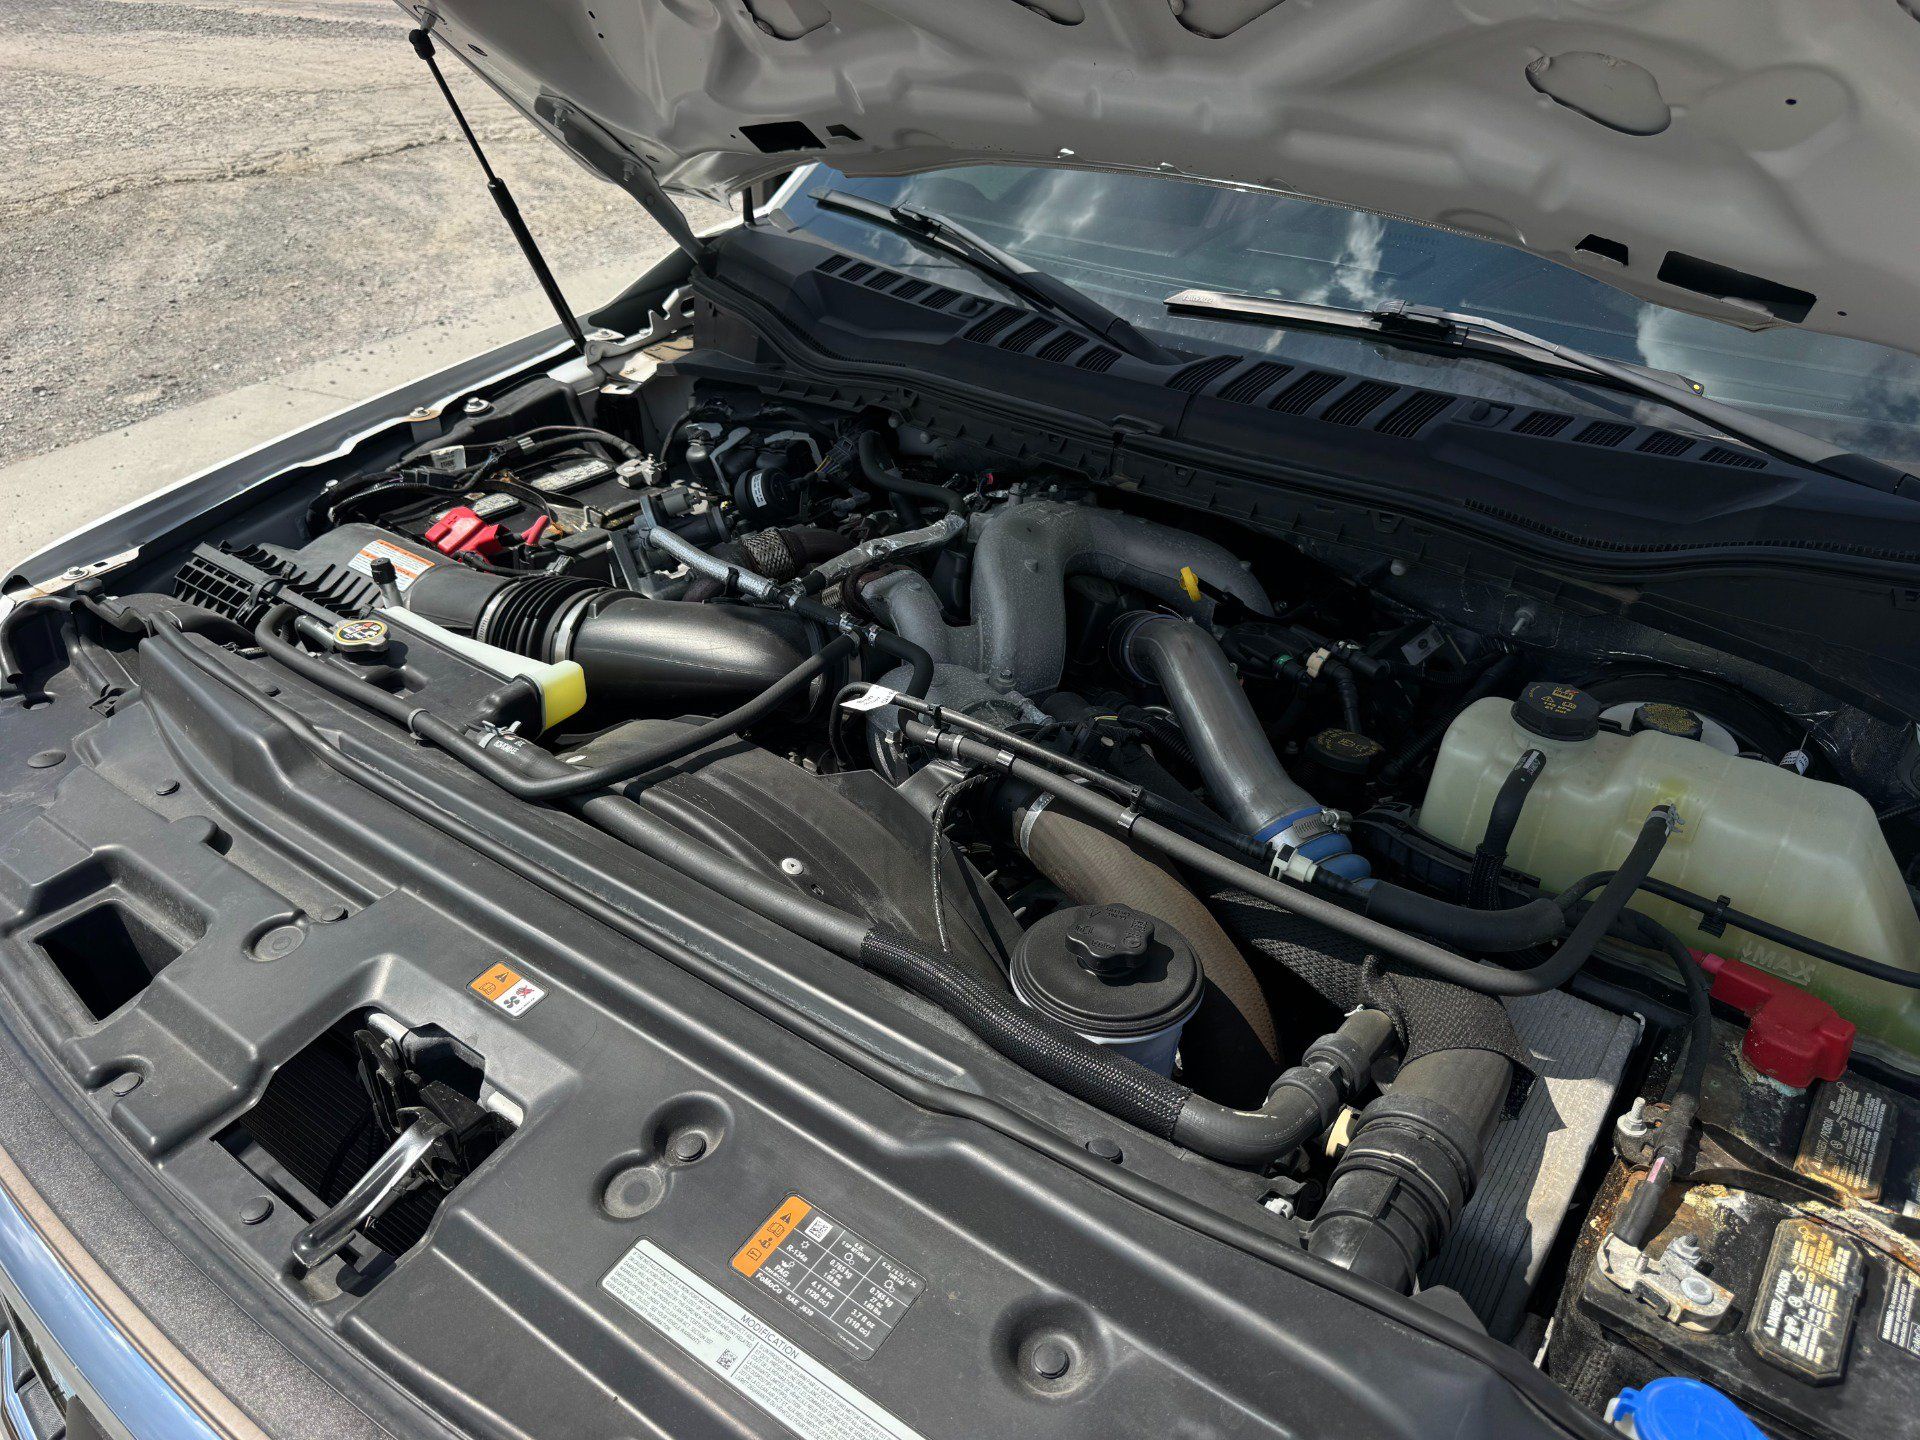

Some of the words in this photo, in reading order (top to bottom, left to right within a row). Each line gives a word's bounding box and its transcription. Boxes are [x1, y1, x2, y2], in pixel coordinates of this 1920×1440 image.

[1752, 945, 1816, 982] MAX
[785, 1243, 809, 1262] R-134a
[773, 1264, 790, 1278] PAG
[828, 1258, 846, 1273] 0.765
[841, 1268, 854, 1279] kg
[810, 1279, 822, 1289] 4.1
[819, 1286, 827, 1294] fl
[824, 1291, 835, 1300] oz
[822, 1272, 834, 1282] 1.69
[831, 1278, 842, 1287] lbs
[754, 1271, 784, 1294] FoMoCo
[784, 1293, 800, 1306] SAE
[797, 1303, 815, 1317] J639
[803, 1286, 820, 1301] (120
[816, 1296, 830, 1308] cc)
[868, 1286, 886, 1301] 0.765
[882, 1296, 894, 1308] kg
[869, 1296, 877, 1304] 27
[875, 1301, 884, 1309] oz
[862, 1299, 875, 1310] 1.69
[871, 1306, 882, 1316] lbs
[843, 1315, 861, 1330] (110
[857, 1325, 871, 1338] cc)
[850, 1308, 862, 1318] 3.7
[859, 1314, 868, 1323] fl
[865, 1319, 876, 1329] oz
[739, 1313, 800, 1359] MODIFICATION
